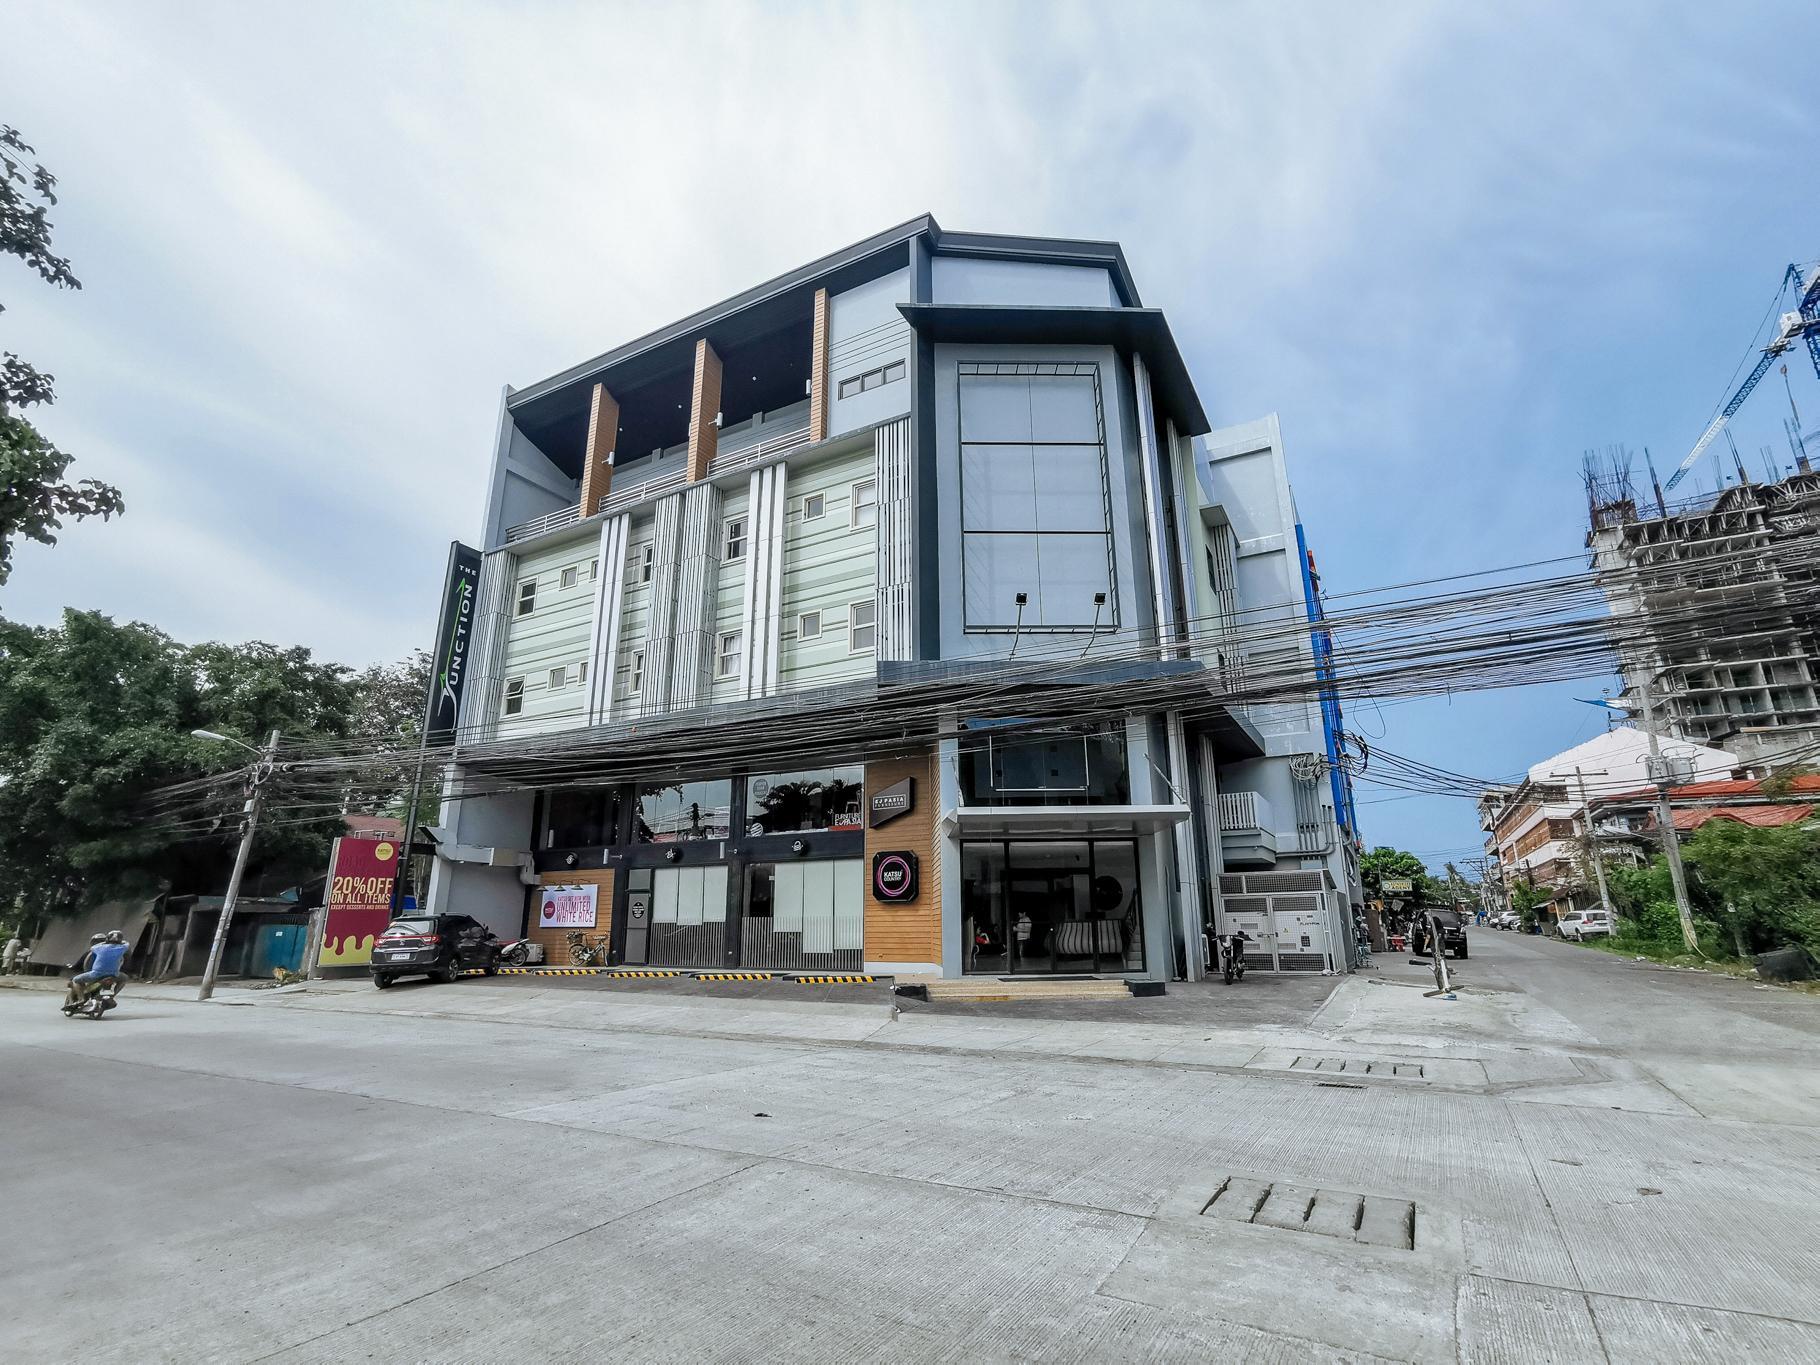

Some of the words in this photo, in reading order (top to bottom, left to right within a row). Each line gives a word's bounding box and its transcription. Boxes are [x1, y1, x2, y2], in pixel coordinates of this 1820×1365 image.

[458, 564, 477, 576] THE
[331, 893, 344, 904] ON
[346, 893, 362, 904] ALL
[364, 893, 391, 904] ITEMS
[557, 900, 591, 912] UNLIMITED
[556, 911, 577, 923] WHITE
[578, 911, 593, 923] RICE
